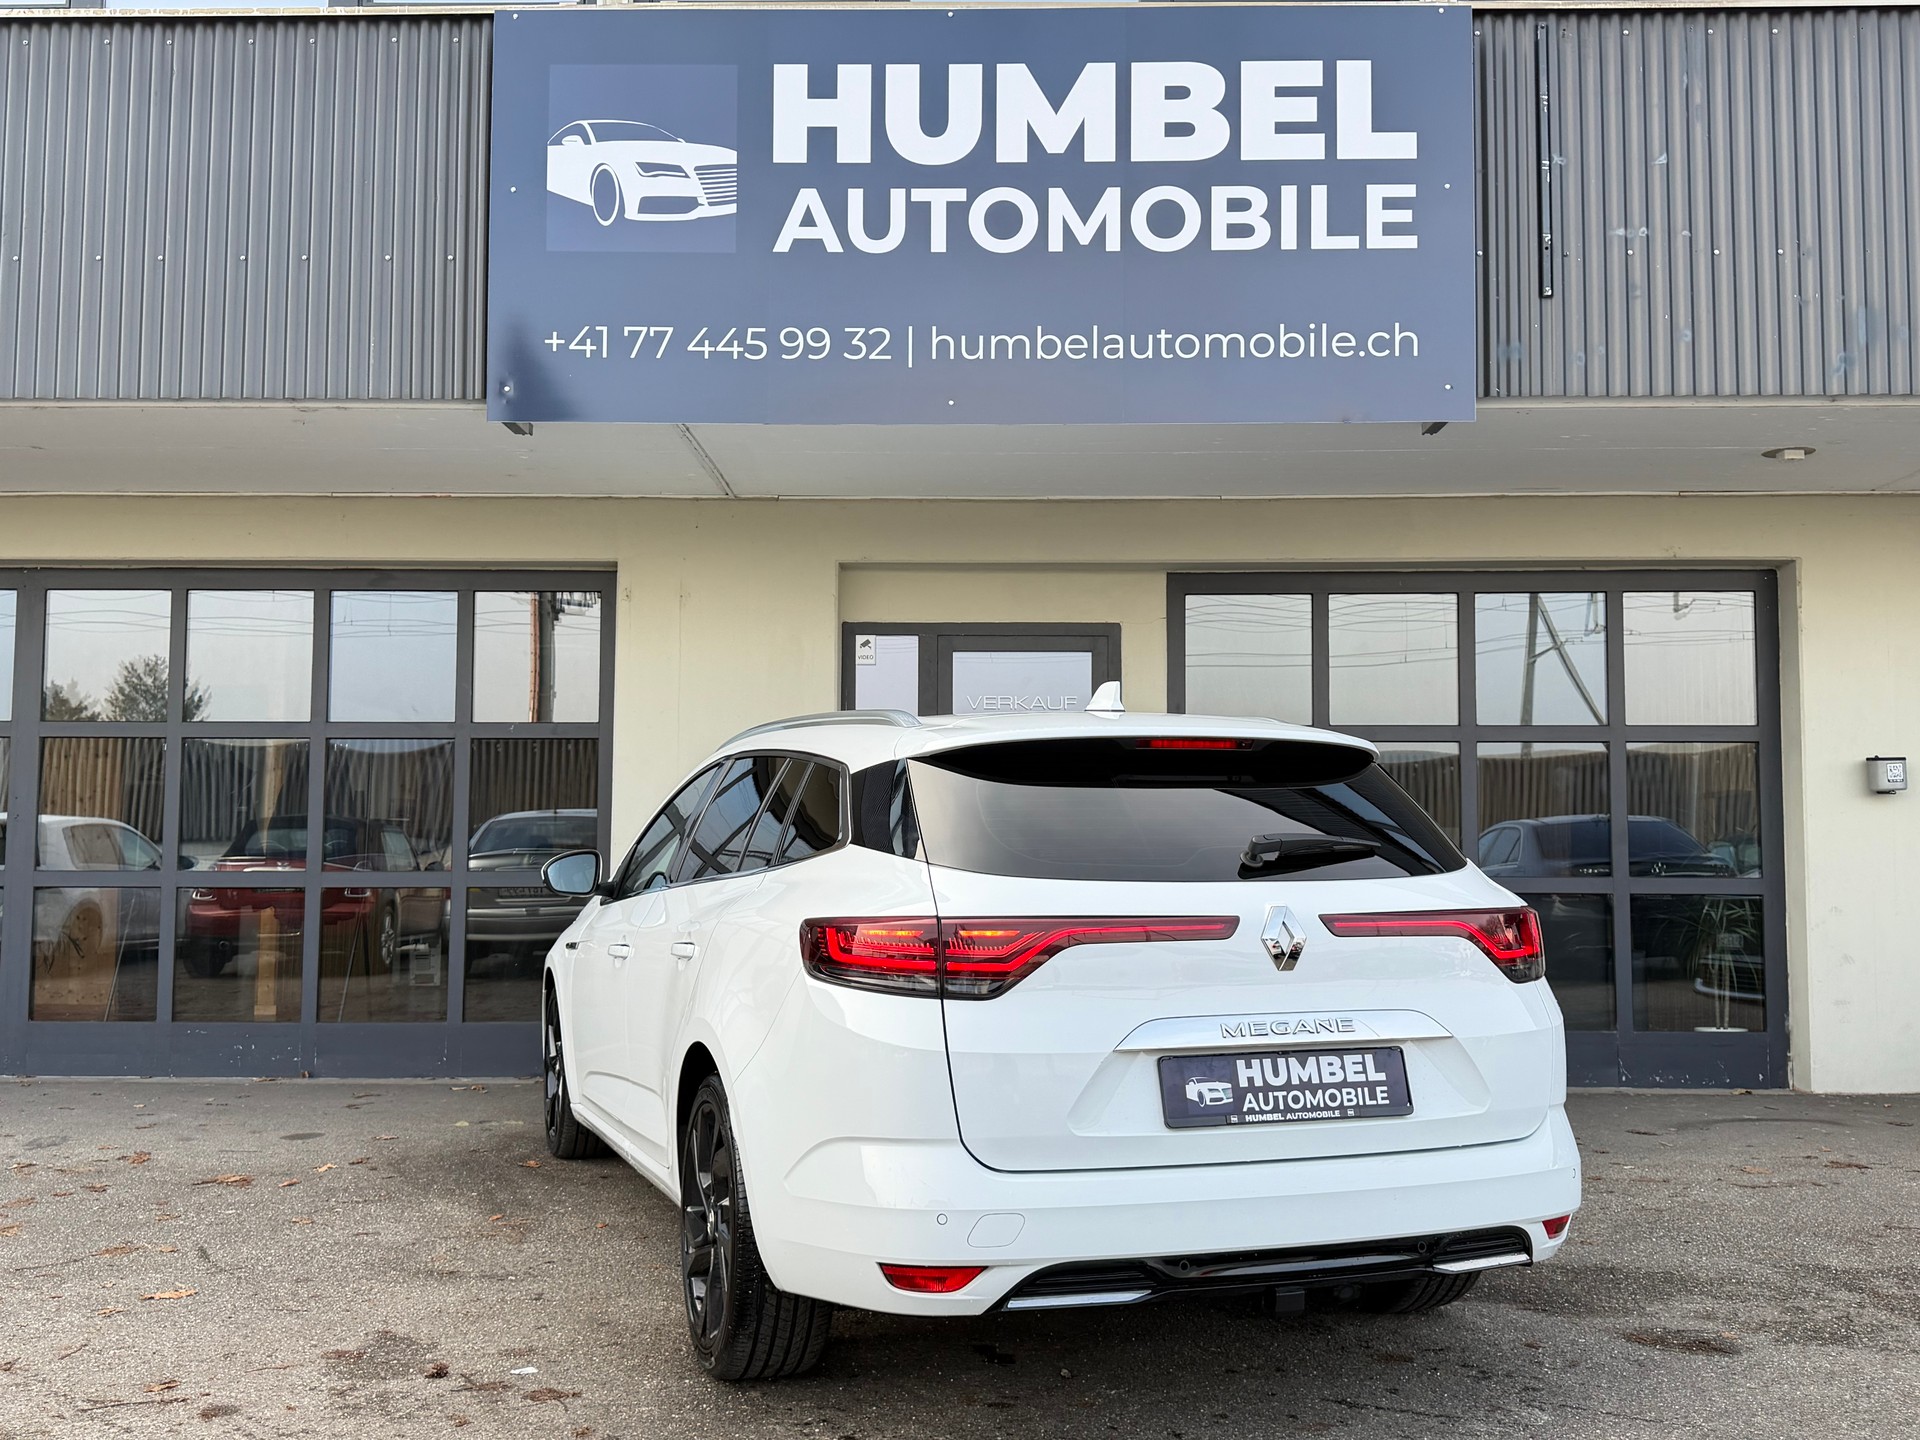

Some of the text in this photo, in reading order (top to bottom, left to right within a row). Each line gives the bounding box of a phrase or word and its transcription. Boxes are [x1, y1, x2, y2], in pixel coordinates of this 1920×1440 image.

[772, 60, 1418, 166] HUMBEL
[772, 184, 1418, 254] AUTOMOBILE
[544, 325, 608, 359] +41
[623, 326, 674, 359] 77
[686, 327, 768, 360] 445
[779, 327, 831, 360] 99
[843, 327, 892, 360] 32
[931, 322, 1419, 360] humbelautomobile.ch
[967, 695, 1078, 711] VERKAUF
[1220, 1018, 1355, 1038] MEGANE
[1236, 1054, 1387, 1088] HUMBEL
[1242, 1086, 1390, 1112] AUTOMOBILE
[1245, 1110, 1341, 1122] HUMBEL AUTOMOBILE
